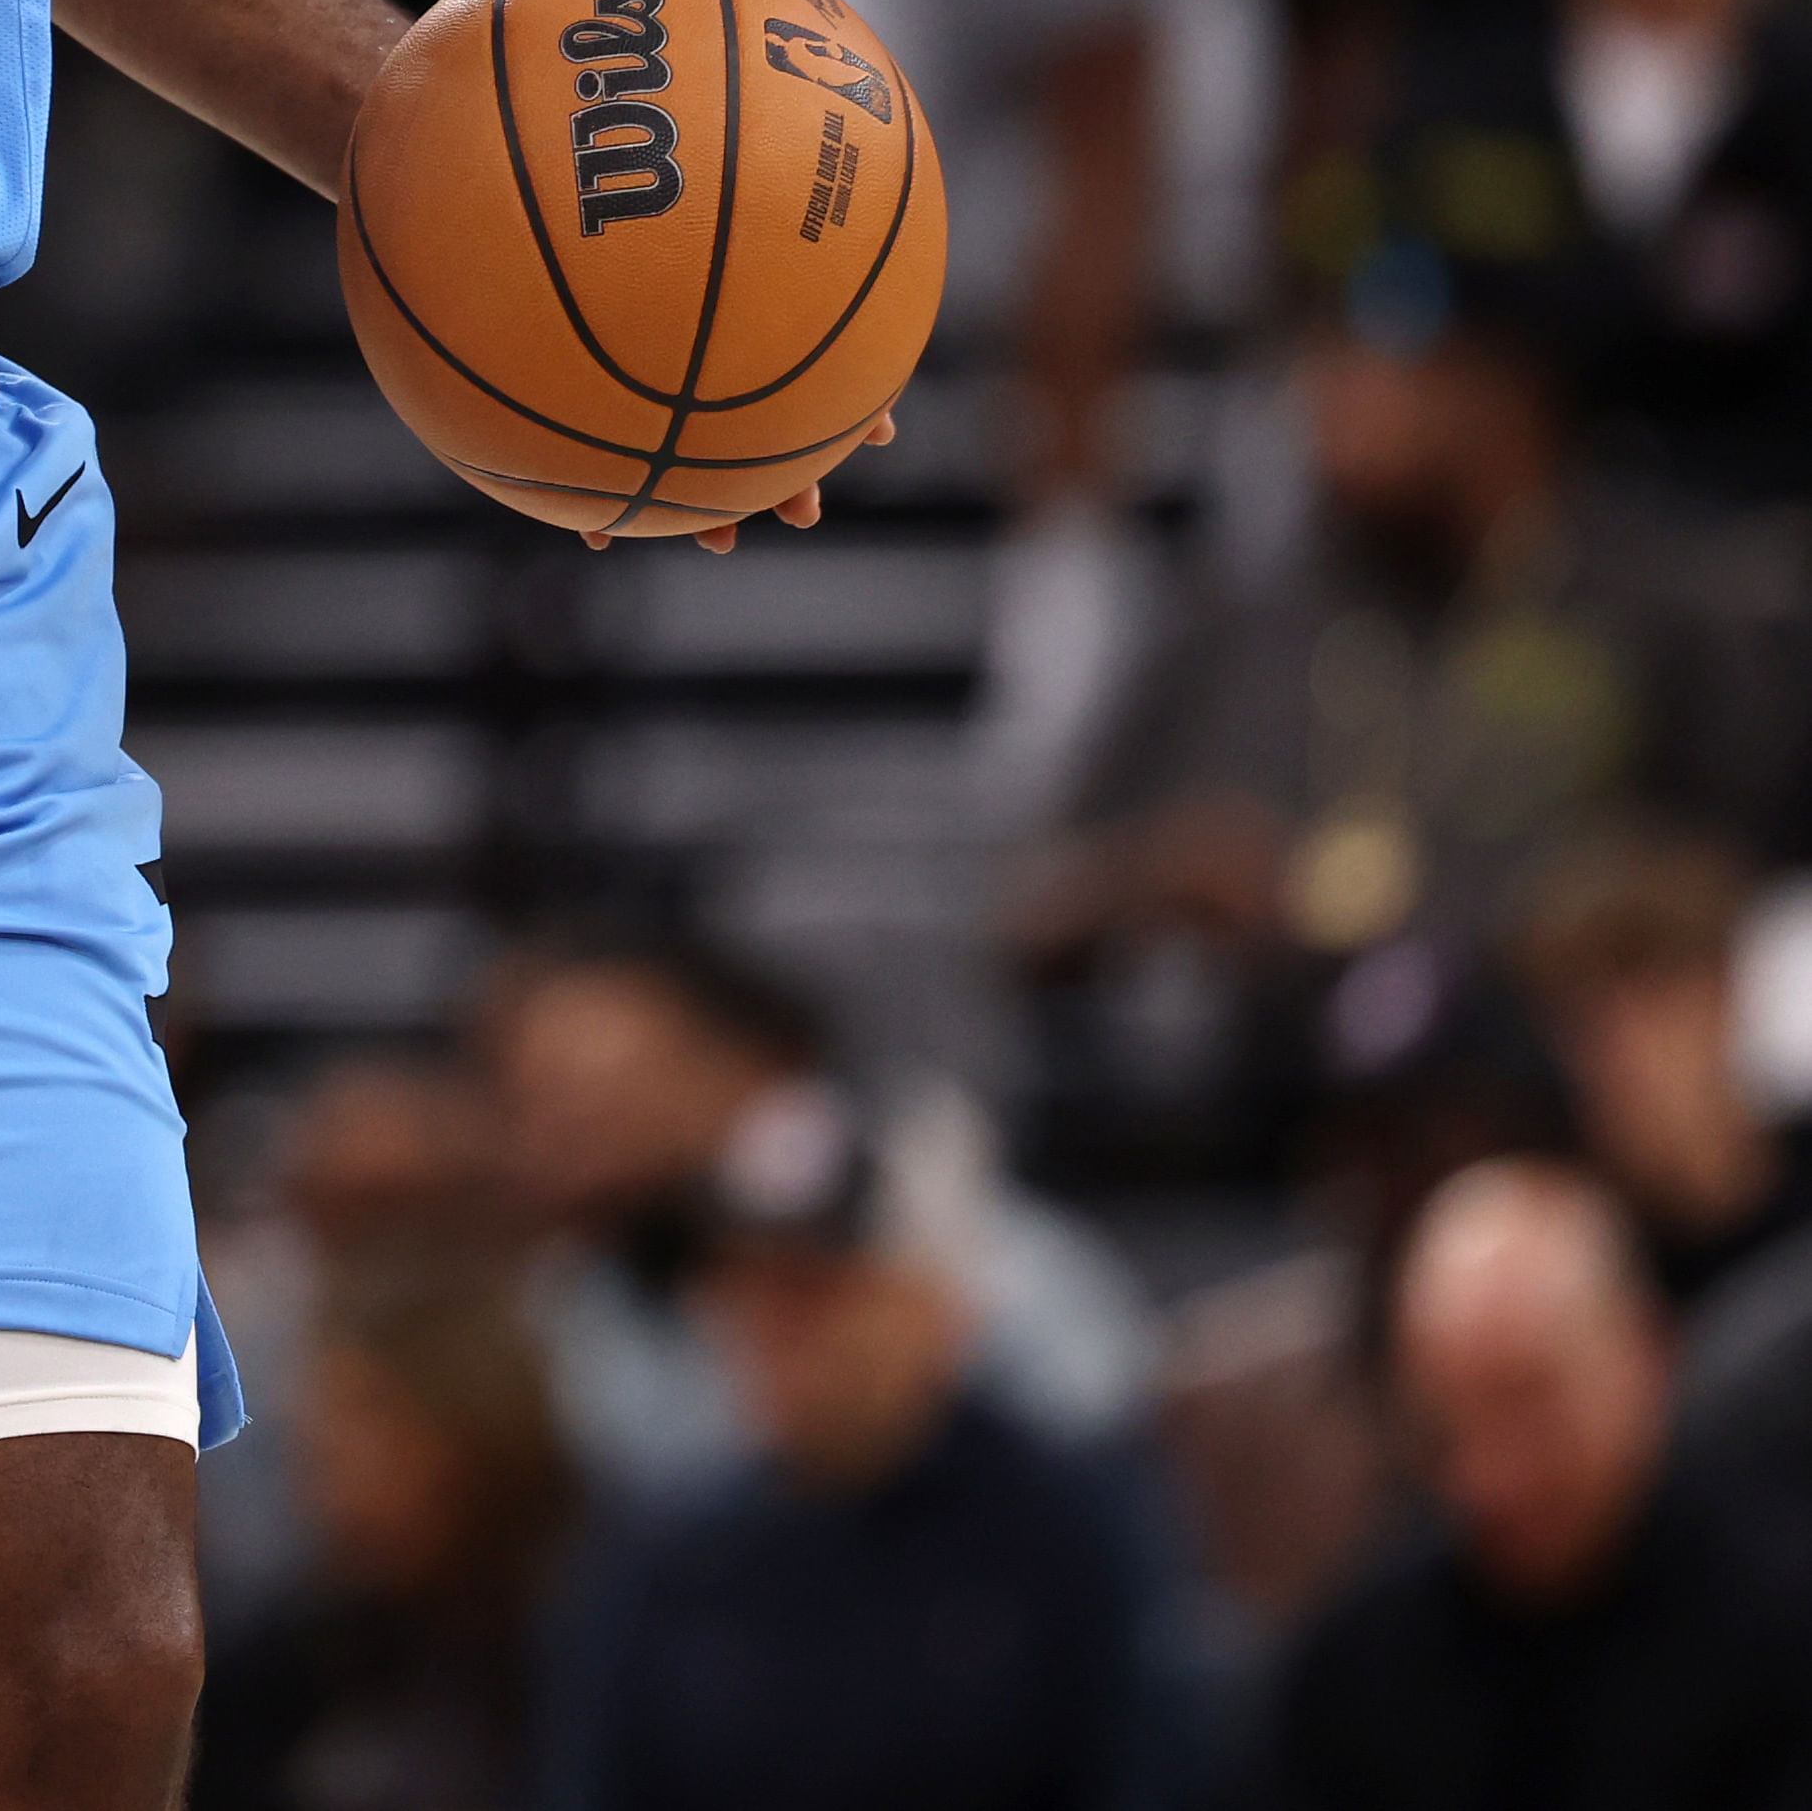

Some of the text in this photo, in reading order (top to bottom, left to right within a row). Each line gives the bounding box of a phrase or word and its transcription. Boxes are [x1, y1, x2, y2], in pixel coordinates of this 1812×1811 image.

[799, 109, 844, 243] OFFICIAL GAME BALL
[830, 142, 859, 227] GENUINE LEATHER
